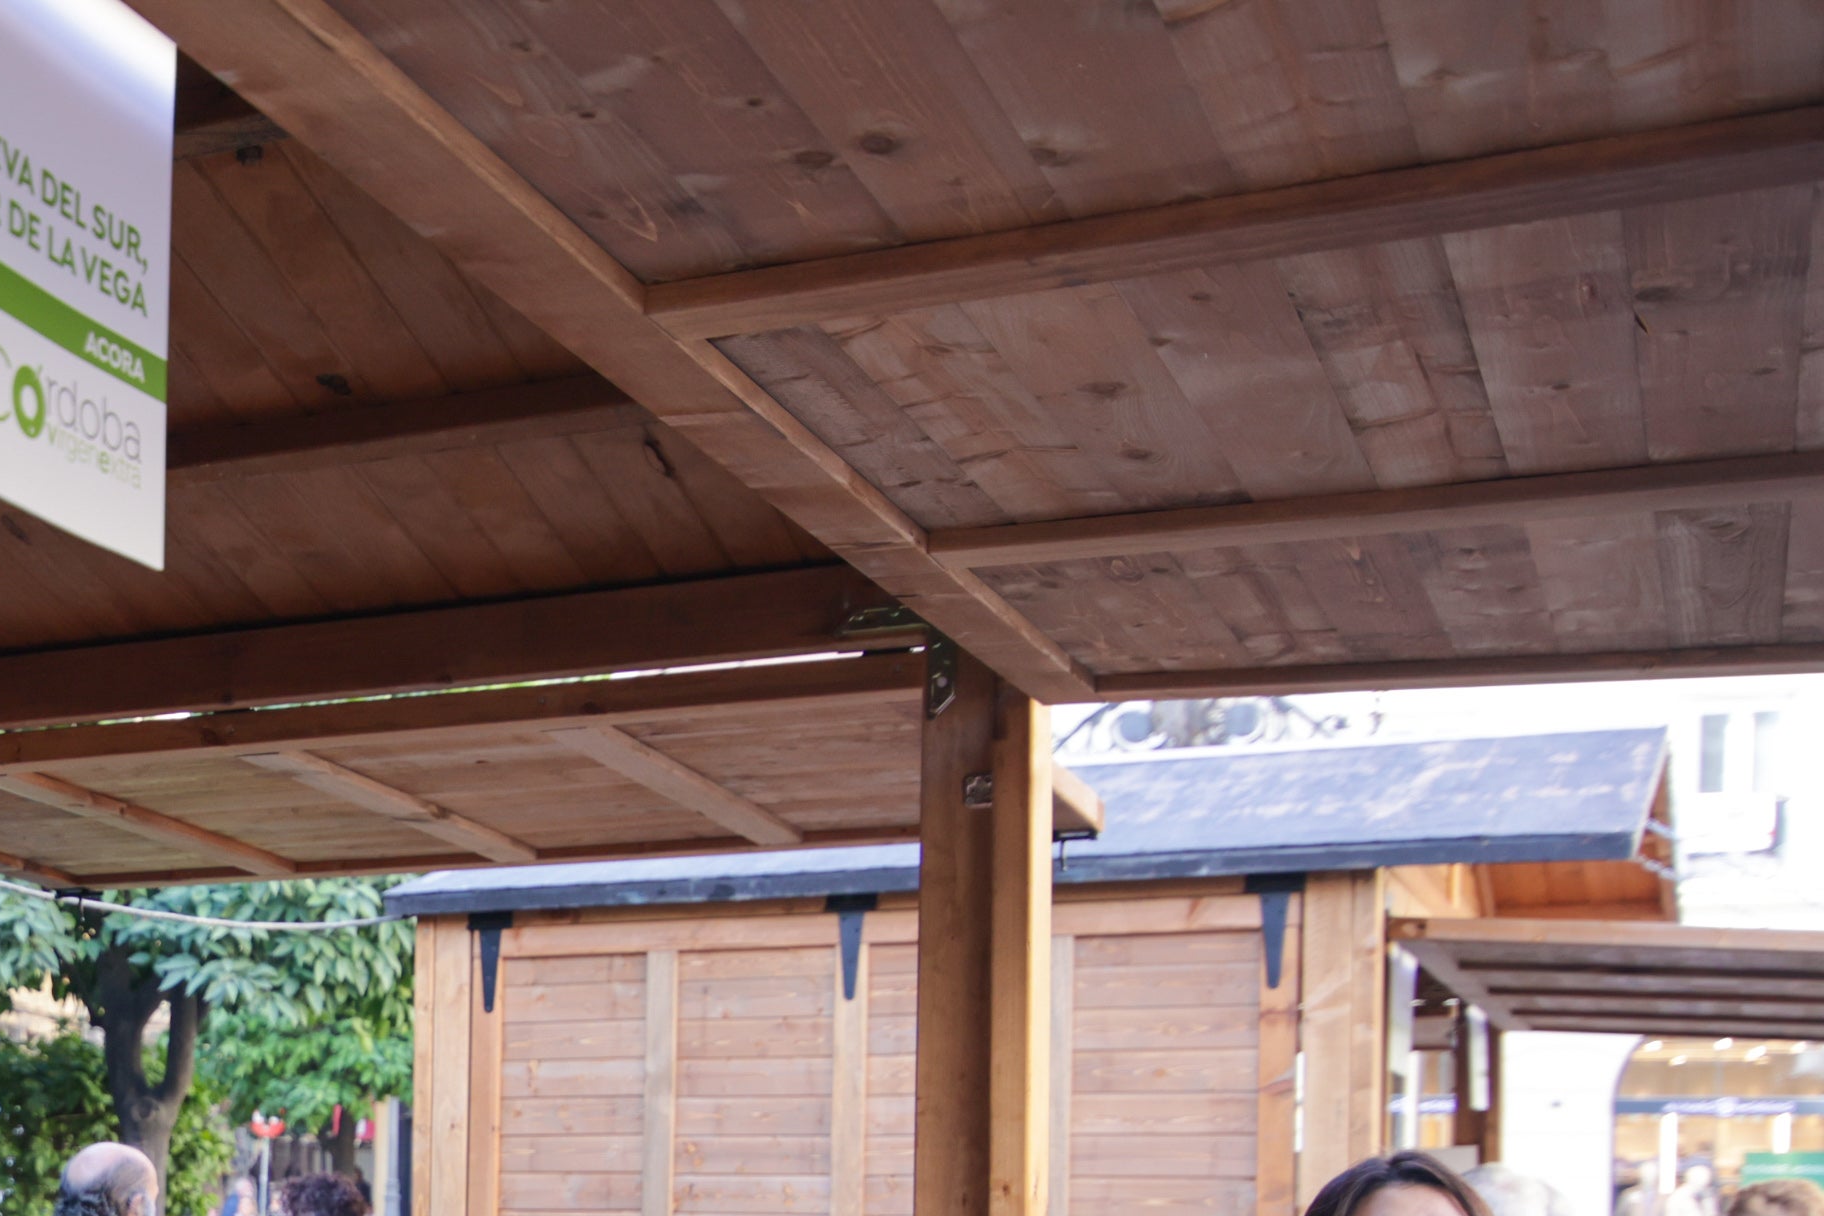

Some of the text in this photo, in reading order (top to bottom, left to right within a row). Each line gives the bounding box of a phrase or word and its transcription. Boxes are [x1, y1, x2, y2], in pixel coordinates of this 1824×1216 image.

[9, 199, 40, 251] DE
[48, 225, 76, 276] LA
[81, 246, 147, 317] VEGA
[41, 169, 87, 229] DEL
[93, 204, 148, 274] SUR,
[84, 331, 145, 384] ACORA
